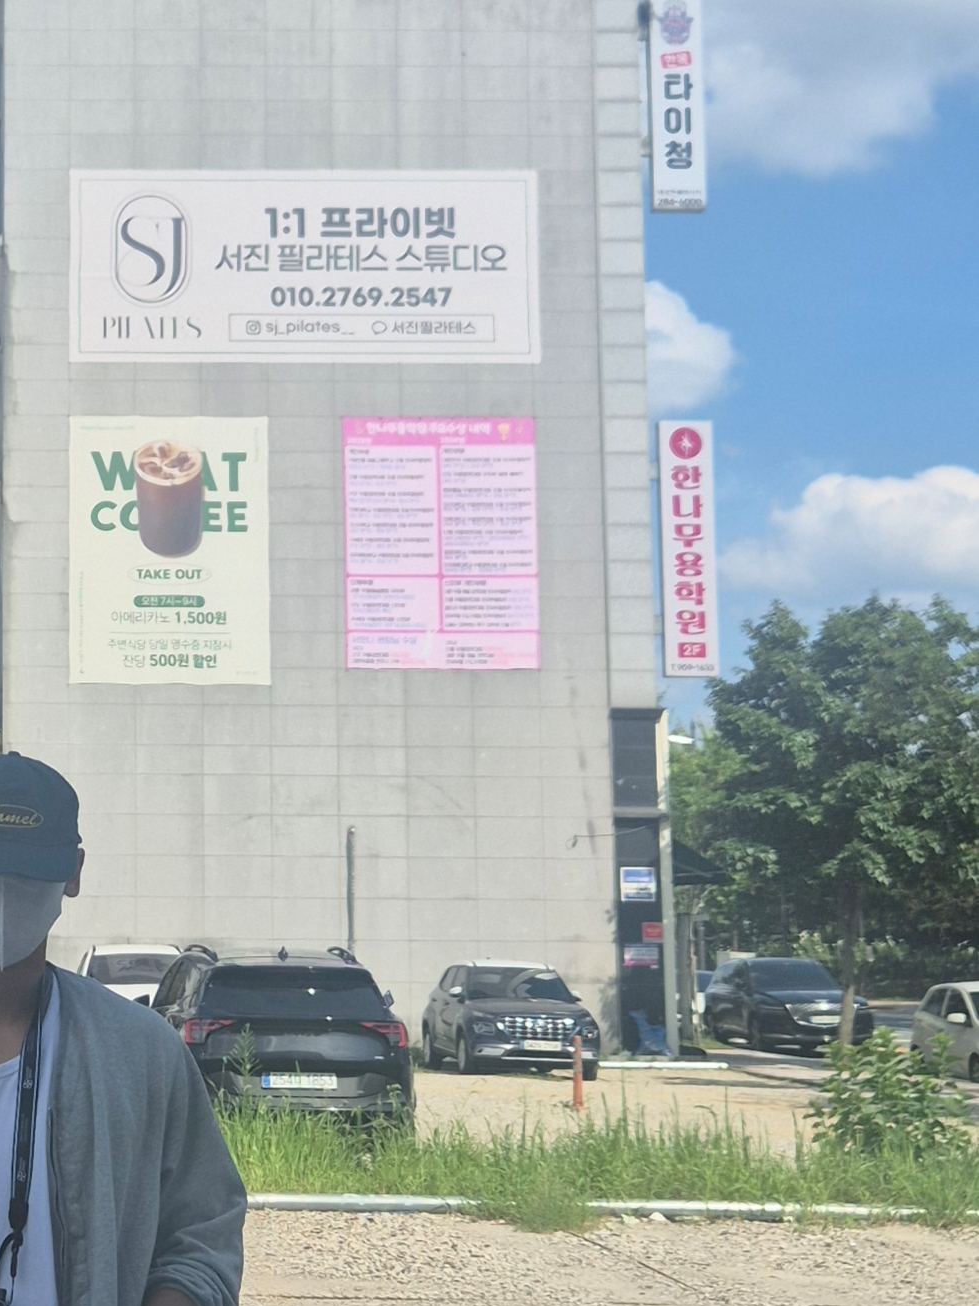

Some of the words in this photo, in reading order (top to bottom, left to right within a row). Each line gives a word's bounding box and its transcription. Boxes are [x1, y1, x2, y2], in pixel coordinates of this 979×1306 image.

[264, 207, 306, 238] 1:1
[321, 207, 456, 238] 프라이빗
[215, 244, 270, 273] 서진
[278, 244, 389, 273] 필라테스
[395, 244, 508, 272] 스튜디오
[270, 286, 452, 307] 010.2769.2547
[391, 319, 477, 335] 서진필라테스
[91, 451, 247, 491] WT
[90, 500, 248, 532] COEE
[670, 465, 706, 635] 한나무용학원
[136, 569, 171, 580] TAKE
[175, 569, 202, 580] OUT
[111, 611, 171, 624] 아메리카노
[175, 611, 227, 625] 1,500원
[149, 653, 189, 667] 500원
[683, 644, 701, 656] 2F
